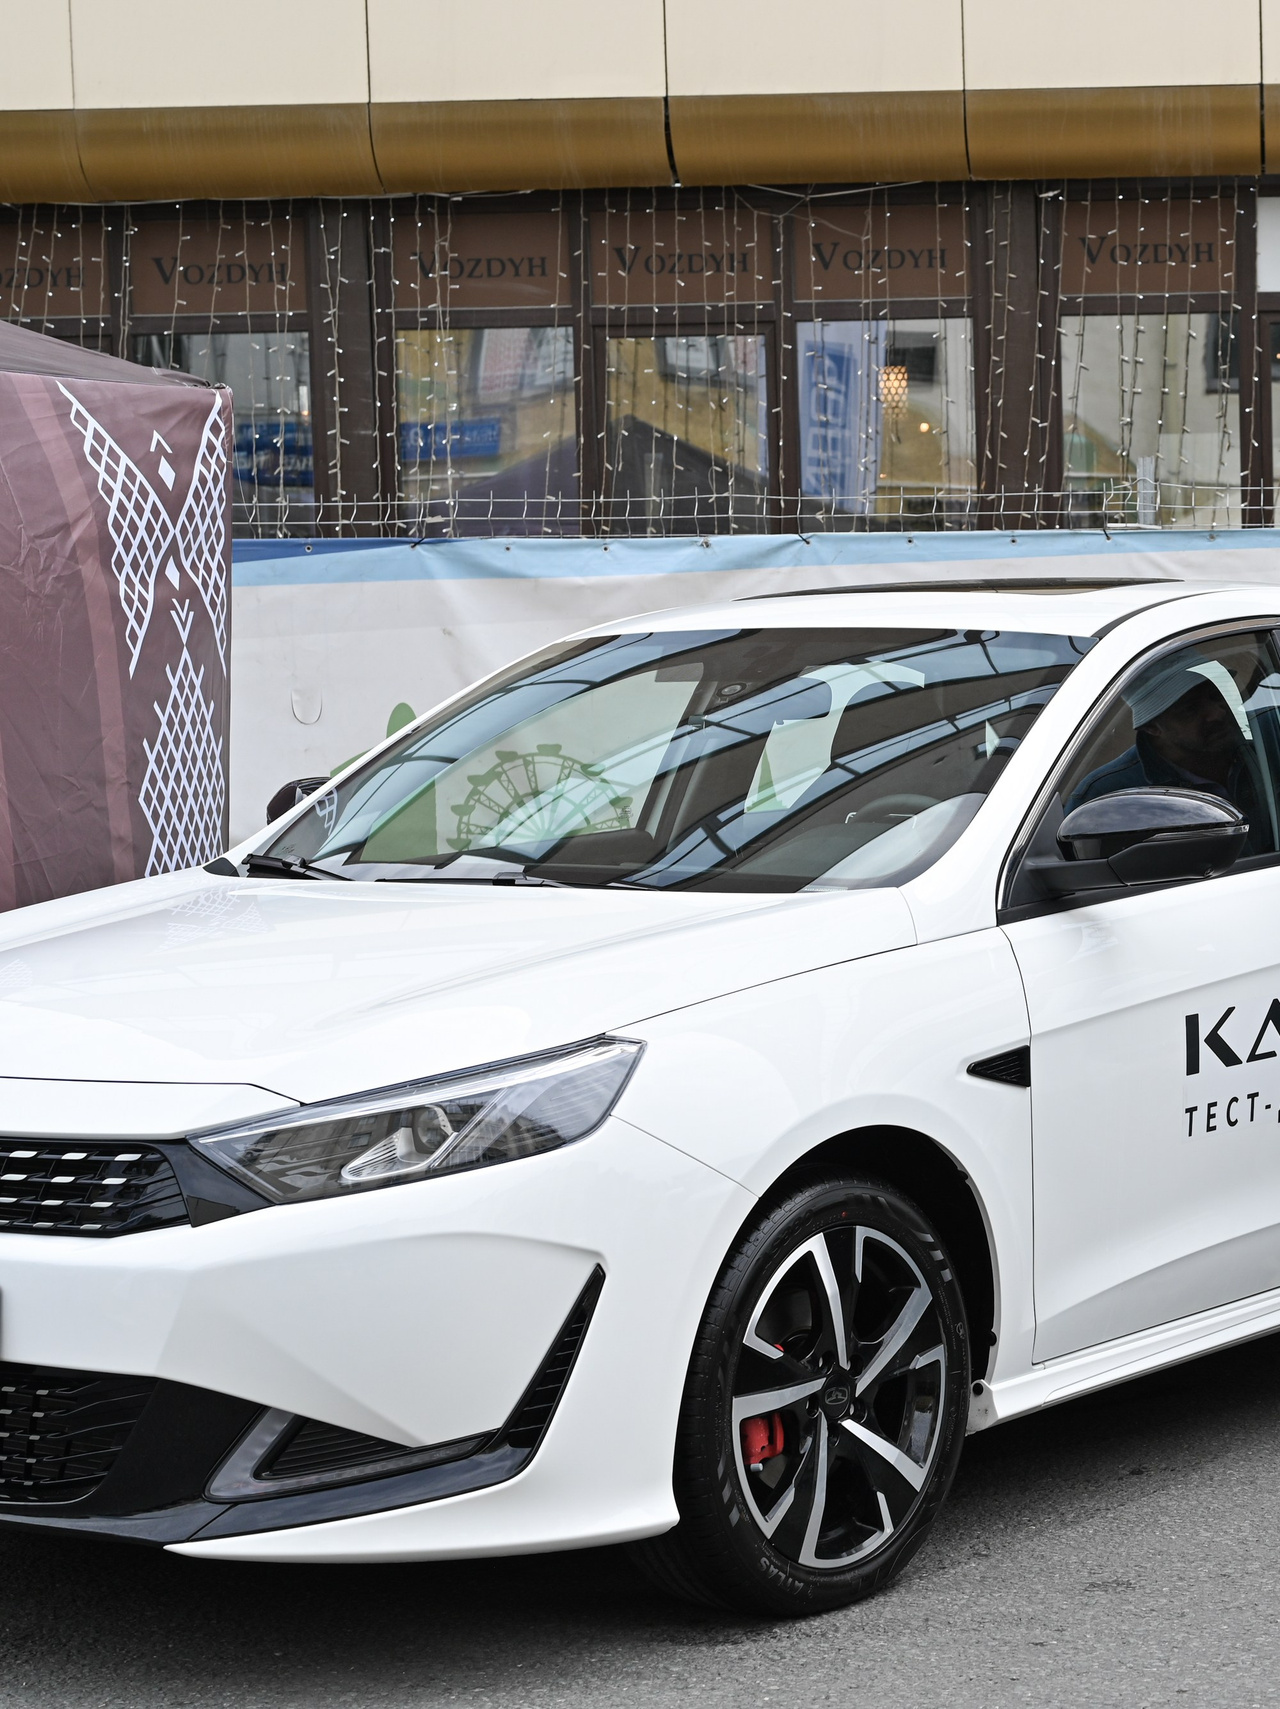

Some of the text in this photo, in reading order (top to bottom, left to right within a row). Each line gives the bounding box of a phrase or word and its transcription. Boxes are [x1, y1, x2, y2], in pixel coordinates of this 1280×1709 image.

[612, 246, 749, 276] VOZDYH
[812, 242, 948, 271] VOZDYH
[1079, 235, 1215, 265] VOZDYH
[0, 266, 86, 289] ZDYH
[152, 256, 288, 286] VOZDYH
[412, 251, 548, 280] VOZDYH
